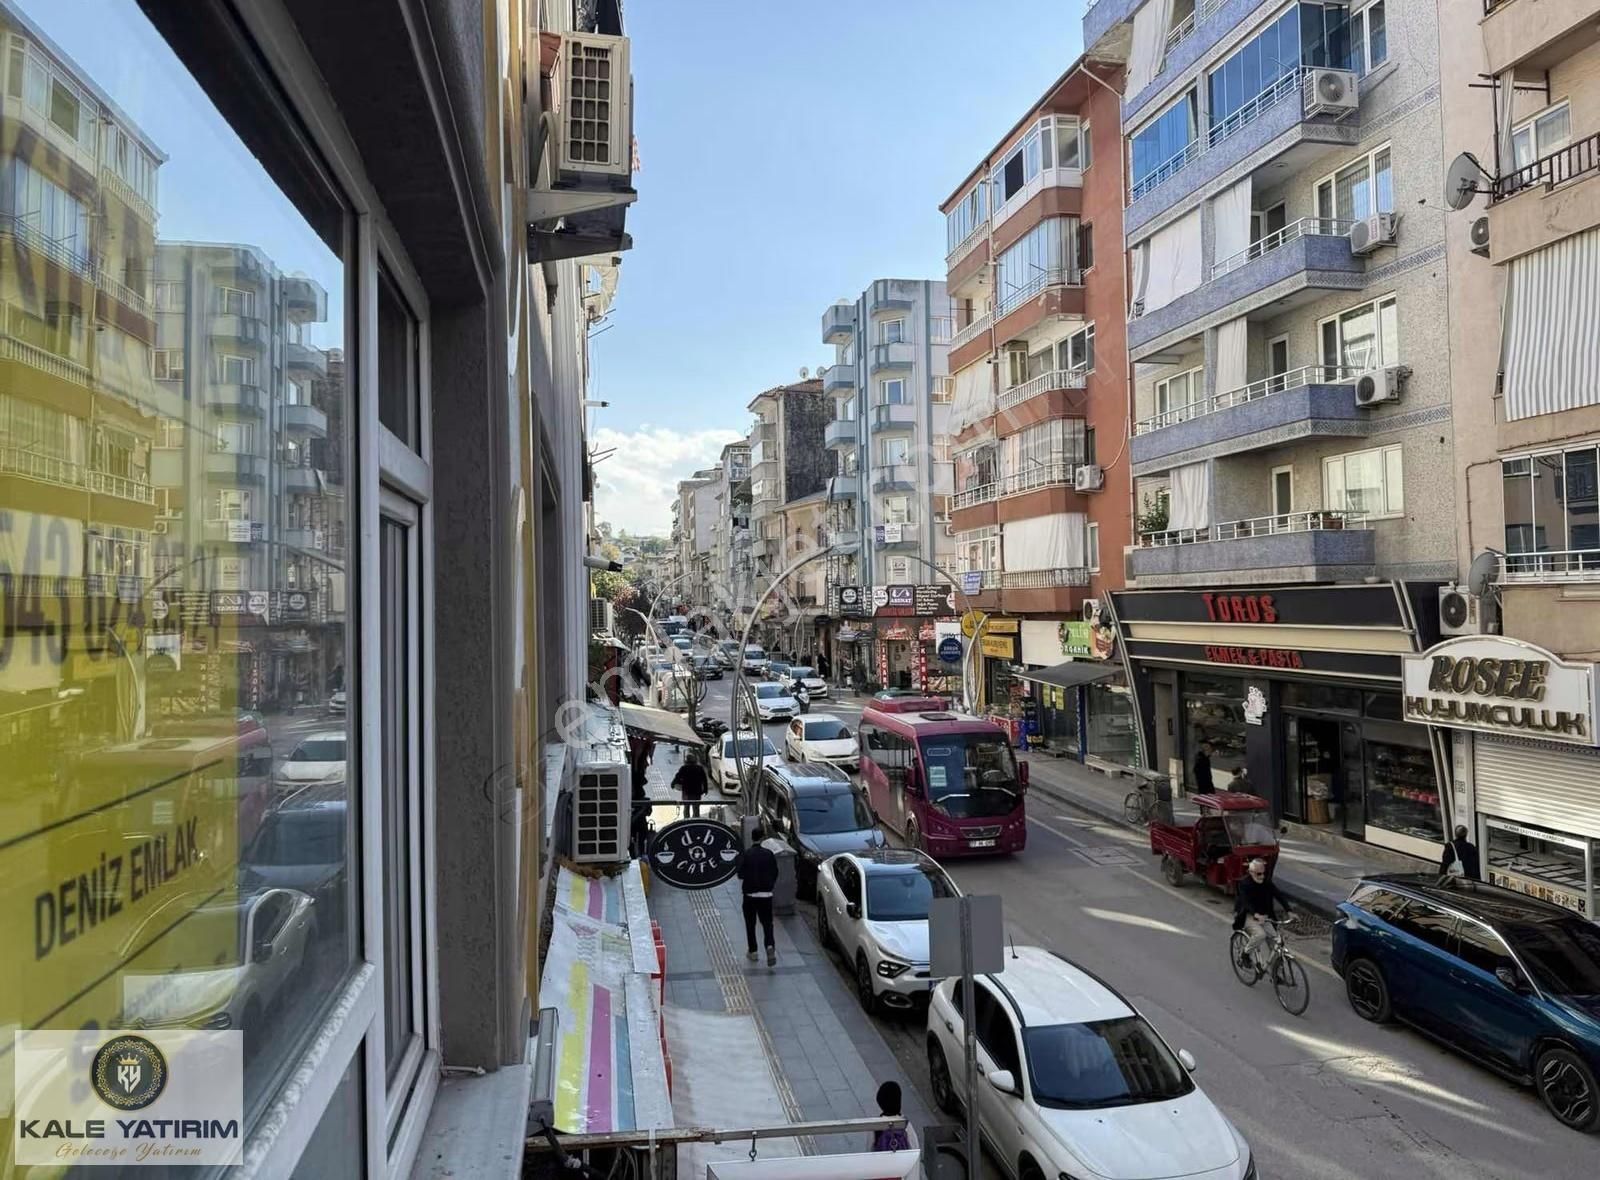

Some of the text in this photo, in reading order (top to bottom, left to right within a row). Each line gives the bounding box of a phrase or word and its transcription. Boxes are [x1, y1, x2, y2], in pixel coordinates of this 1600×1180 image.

[1202, 592, 1277, 623] TOROS
[1205, 646, 1304, 669] EKMEK & PASTA
[1429, 655, 1550, 703] ROSEE
[1406, 696, 1586, 737] KUYUMCULUK
[676, 857, 718, 875] CAFE
[34, 815, 201, 962] DENİZ EMLAK
